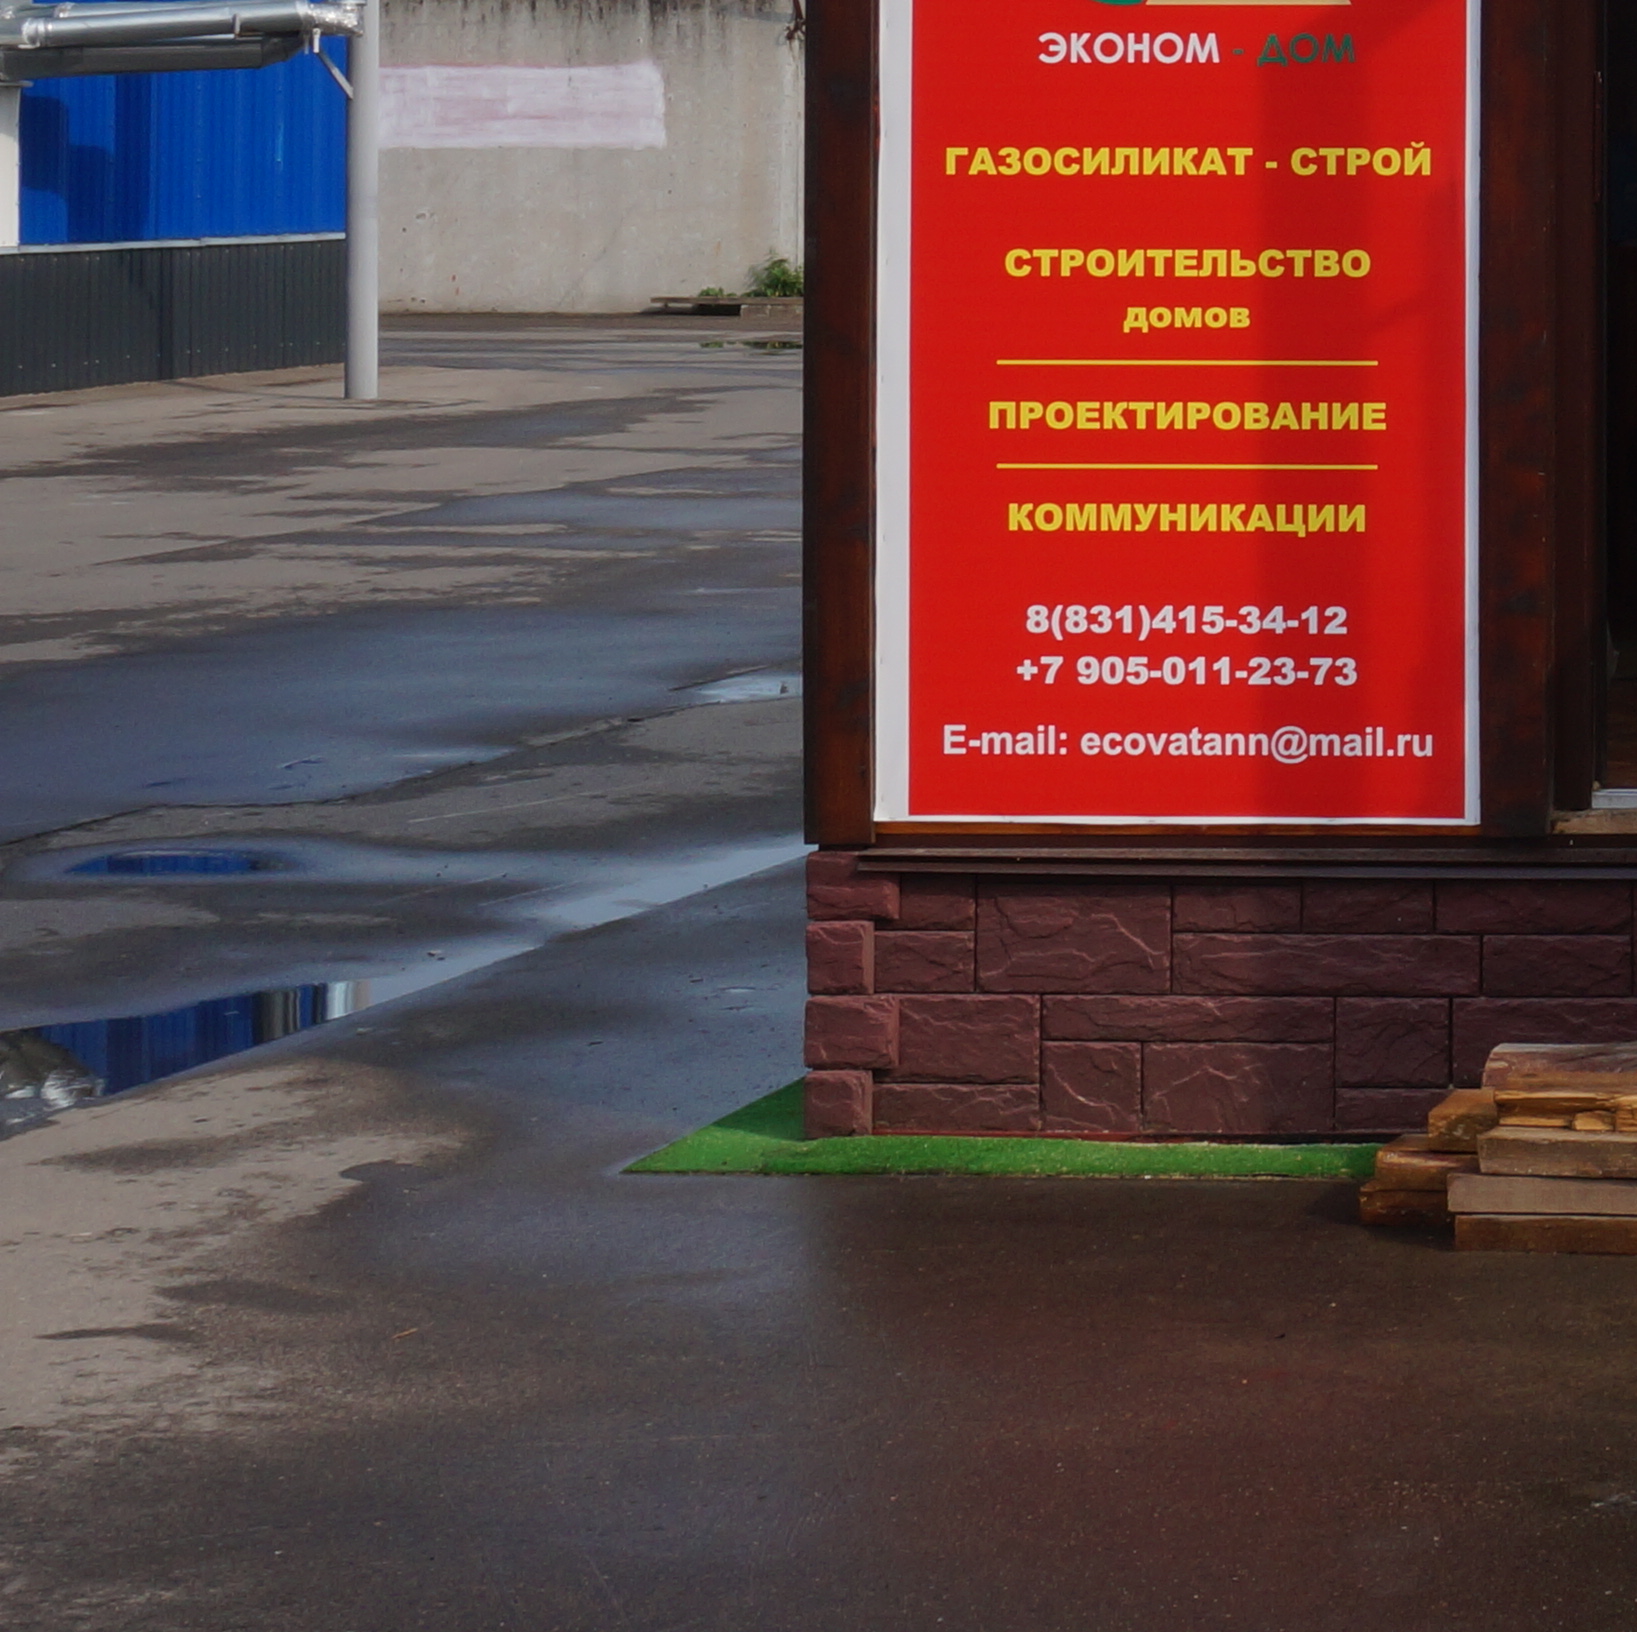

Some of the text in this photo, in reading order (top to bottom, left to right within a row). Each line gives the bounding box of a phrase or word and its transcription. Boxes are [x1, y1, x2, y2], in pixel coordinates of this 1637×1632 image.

[1039, 32, 1219, 64] ЭКОНОМ
[1257, 33, 1355, 67] ДОМ
[946, 147, 1253, 175] ГАЗОСИЛИКАТ
[1291, 142, 1431, 176] СТРОЙ
[1005, 249, 1370, 277] СТРОИТЕЛЬСТВО
[1123, 307, 1250, 333] домов
[990, 401, 1386, 430] ПРОЕКТИРОВАНИЕ
[1009, 503, 1365, 537] КОММУНИКАЦИИ
[1026, 605, 1347, 641] 8(831)415-34-12
[1017, 656, 1357, 685] +7 905-011-23-73
[944, 725, 1432, 764] E-mail: ecovatann@mail.ru
